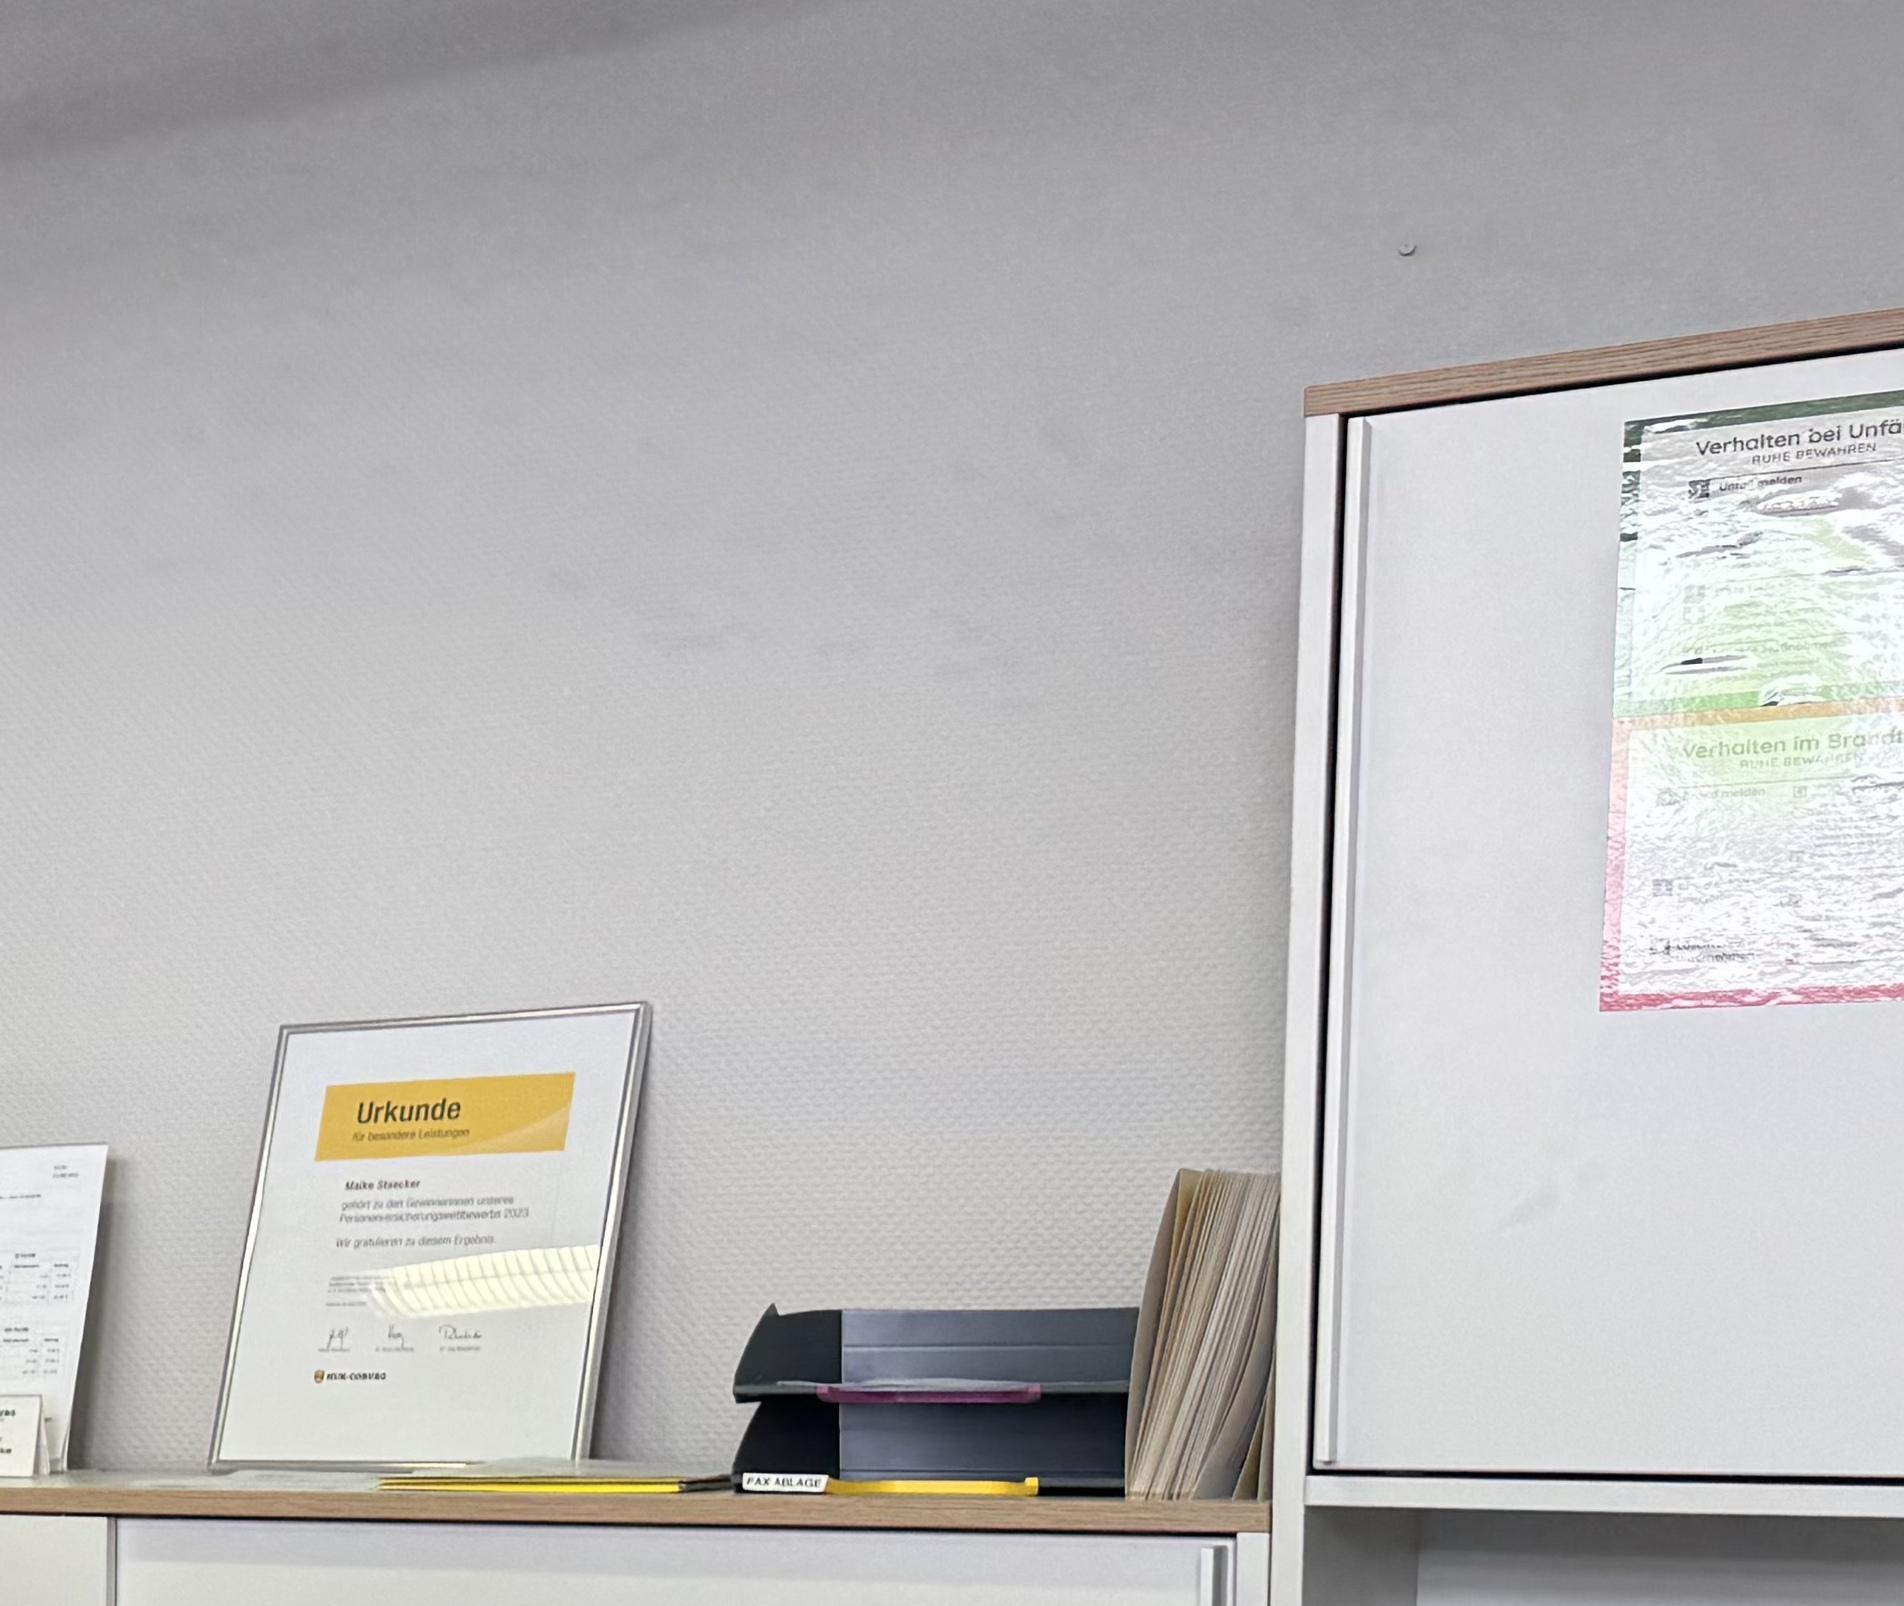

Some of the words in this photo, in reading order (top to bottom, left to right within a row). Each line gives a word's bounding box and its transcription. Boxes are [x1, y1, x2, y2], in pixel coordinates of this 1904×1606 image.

[1696, 432, 1800, 456] Verhalten
[1809, 425, 1841, 443] bei
[1849, 418, 1904, 439] Unfä
[1752, 451, 1791, 465] RUHE
[1796, 443, 1877, 460] BEWAHREN
[1683, 738, 1786, 759] Verhalten
[1794, 735, 1820, 752] im
[357, 1098, 461, 1124] Urkunde
[352, 1131, 365, 1143] für
[368, 1130, 416, 1142] besondere
[418, 1128, 470, 1141] Leistungen
[345, 1181, 374, 1191] Maike
[377, 1179, 420, 1190] Staecker
